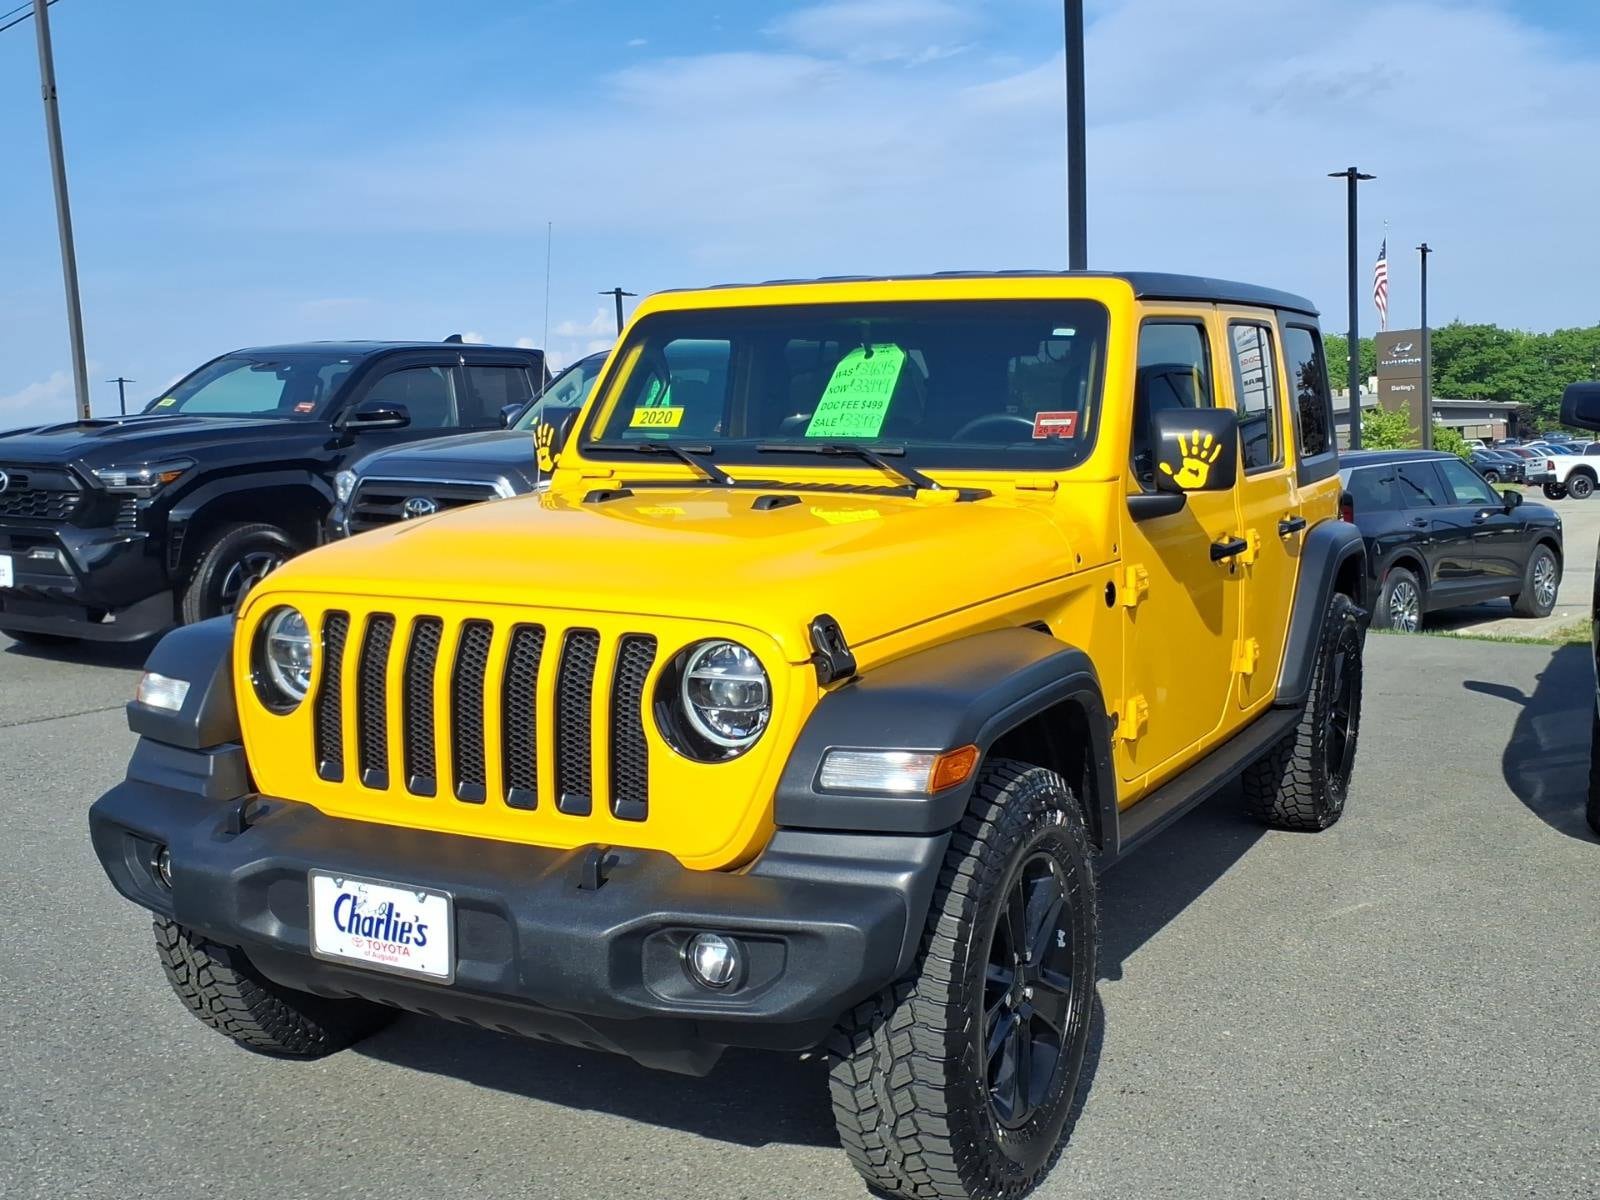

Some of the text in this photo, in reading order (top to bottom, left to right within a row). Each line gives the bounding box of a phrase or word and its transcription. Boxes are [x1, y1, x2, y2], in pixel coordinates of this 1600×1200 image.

[835, 368, 853, 378] WAS
[821, 400, 883, 411] DOC FEE $499
[640, 410, 673, 425] 2020
[813, 418, 837, 427] SALE
[333, 893, 428, 947] Charlie's
[367, 940, 411, 957] TOYOTA
